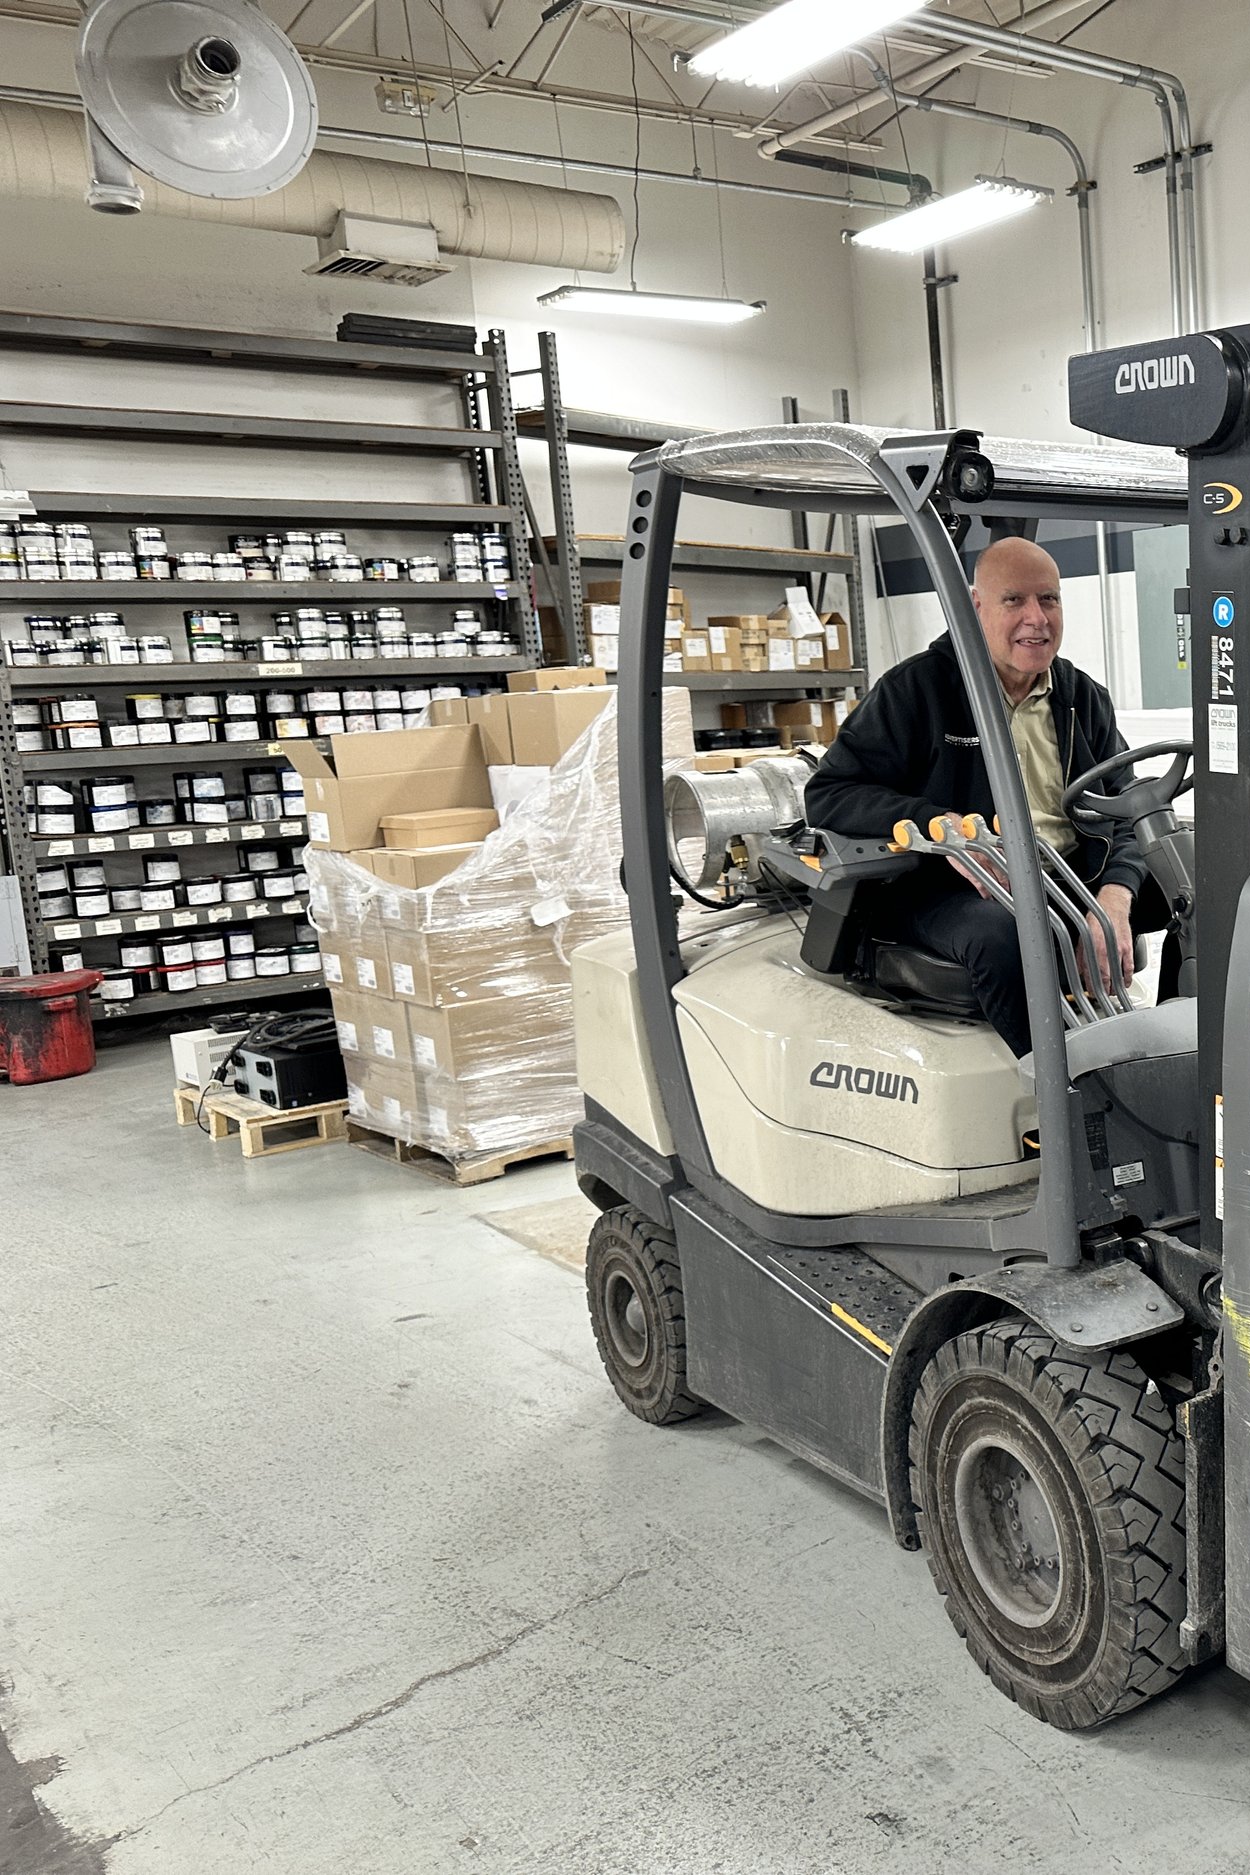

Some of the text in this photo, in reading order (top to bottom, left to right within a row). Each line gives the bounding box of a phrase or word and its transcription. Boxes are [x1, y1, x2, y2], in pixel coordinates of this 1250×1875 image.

[1115, 354, 1195, 394] CROWN
[1218, 604, 1229, 621] R
[1218, 637, 1235, 697] 8471
[1210, 708, 1236, 719] CROWN
[1218, 720, 1236, 728] trucks
[809, 1061, 919, 1105] CROWN
